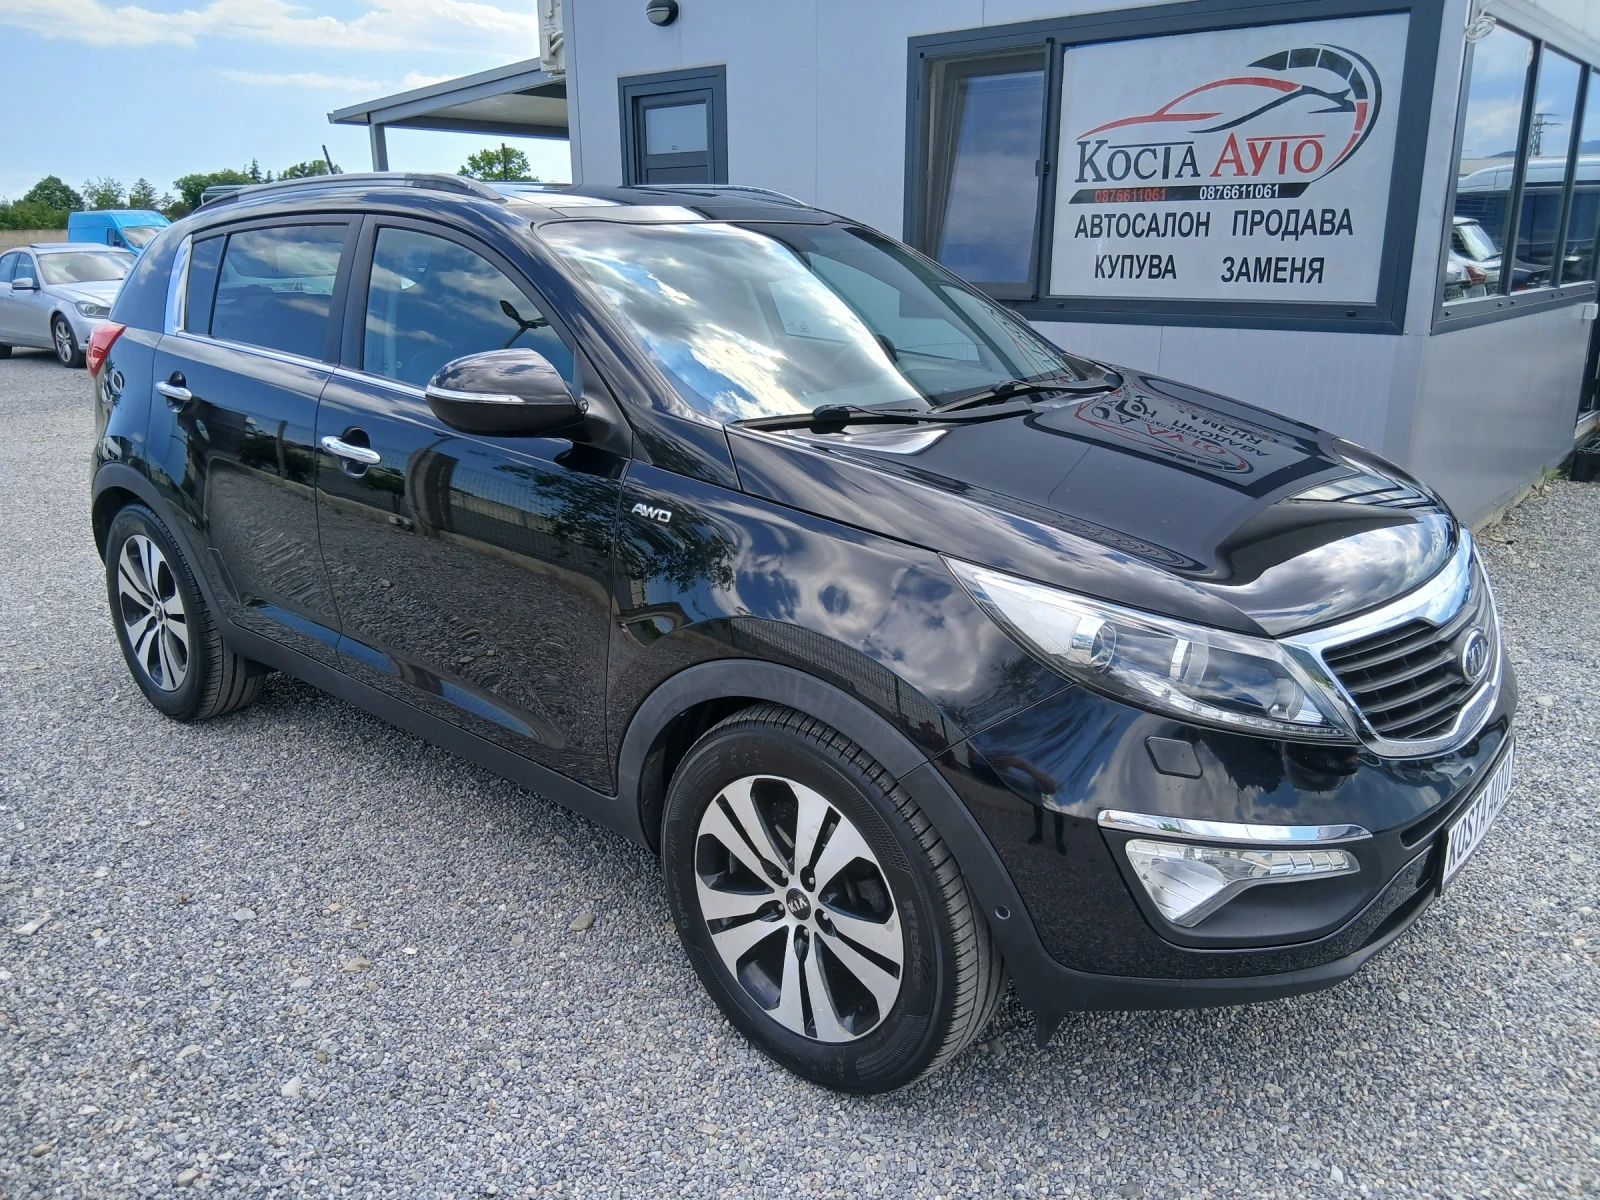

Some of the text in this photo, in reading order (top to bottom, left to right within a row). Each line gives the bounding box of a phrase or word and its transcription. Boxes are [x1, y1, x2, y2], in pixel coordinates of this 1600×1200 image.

[1095, 184, 1280, 203] 0876611061 0876611061
[1074, 208, 1354, 241] АВТОСАЛОН ПРОДАВА
[1094, 254, 1325, 284] КУПУВА ЗАМЕНЯ
[631, 503, 672, 523] AWD
[1447, 790, 1487, 872] KOSTA
[788, 897, 808, 913] KIA
